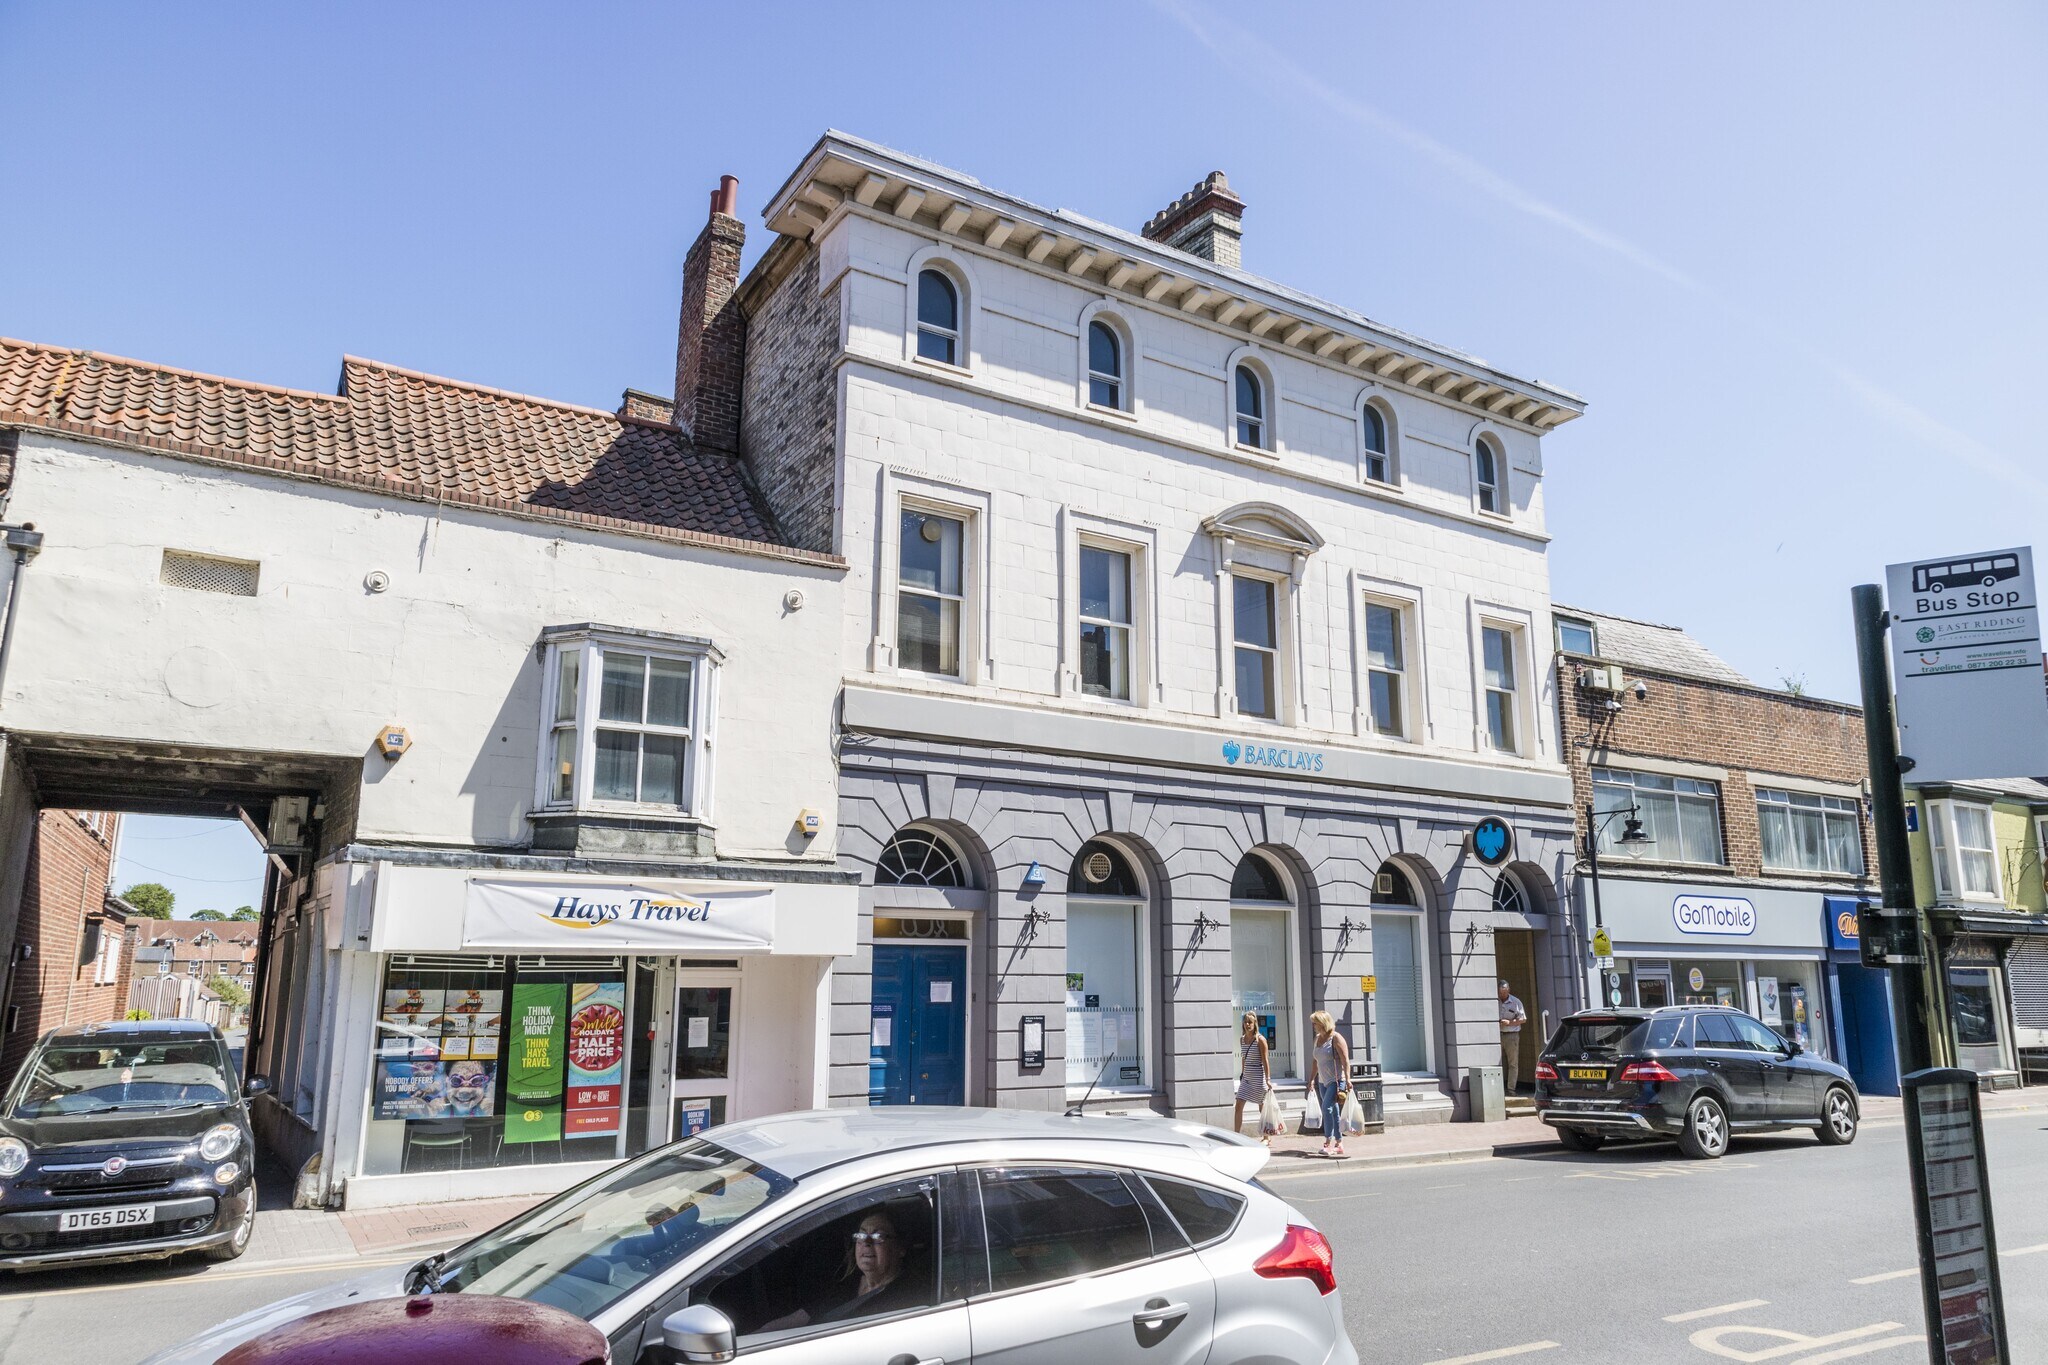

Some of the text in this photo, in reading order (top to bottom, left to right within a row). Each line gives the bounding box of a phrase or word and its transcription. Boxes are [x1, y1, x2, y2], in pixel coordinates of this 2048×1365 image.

[1916, 591, 2020, 613] Bus Stop
[1938, 616, 2025, 632] EAST RIDING
[1966, 649, 2026, 659] www.traveline.info
[1922, 664, 1962, 673] traveline
[1245, 745, 1323, 772] BARCLAYS
[551, 897, 711, 925] Hays Travel
[1680, 904, 1750, 927] GoMobile
[528, 1006, 551, 1015] THINK
[523, 1016, 556, 1026] HOLIDAY
[574, 1012, 618, 1035] Smile
[525, 1025, 552, 1035] MONEY
[526, 1038, 550, 1048] THINK
[579, 1037, 615, 1048] HALF
[527, 1048, 547, 1058] HAYS
[578, 1047, 614, 1058] PRICE
[522, 1058, 551, 1068] TRAVEL
[385, 1076, 434, 1085] NOBODY OFFERS
[385, 1084, 415, 1093] YOU MORE
[579, 1091, 592, 1099] LOW
[69, 1208, 148, 1228] DT65 DSX
